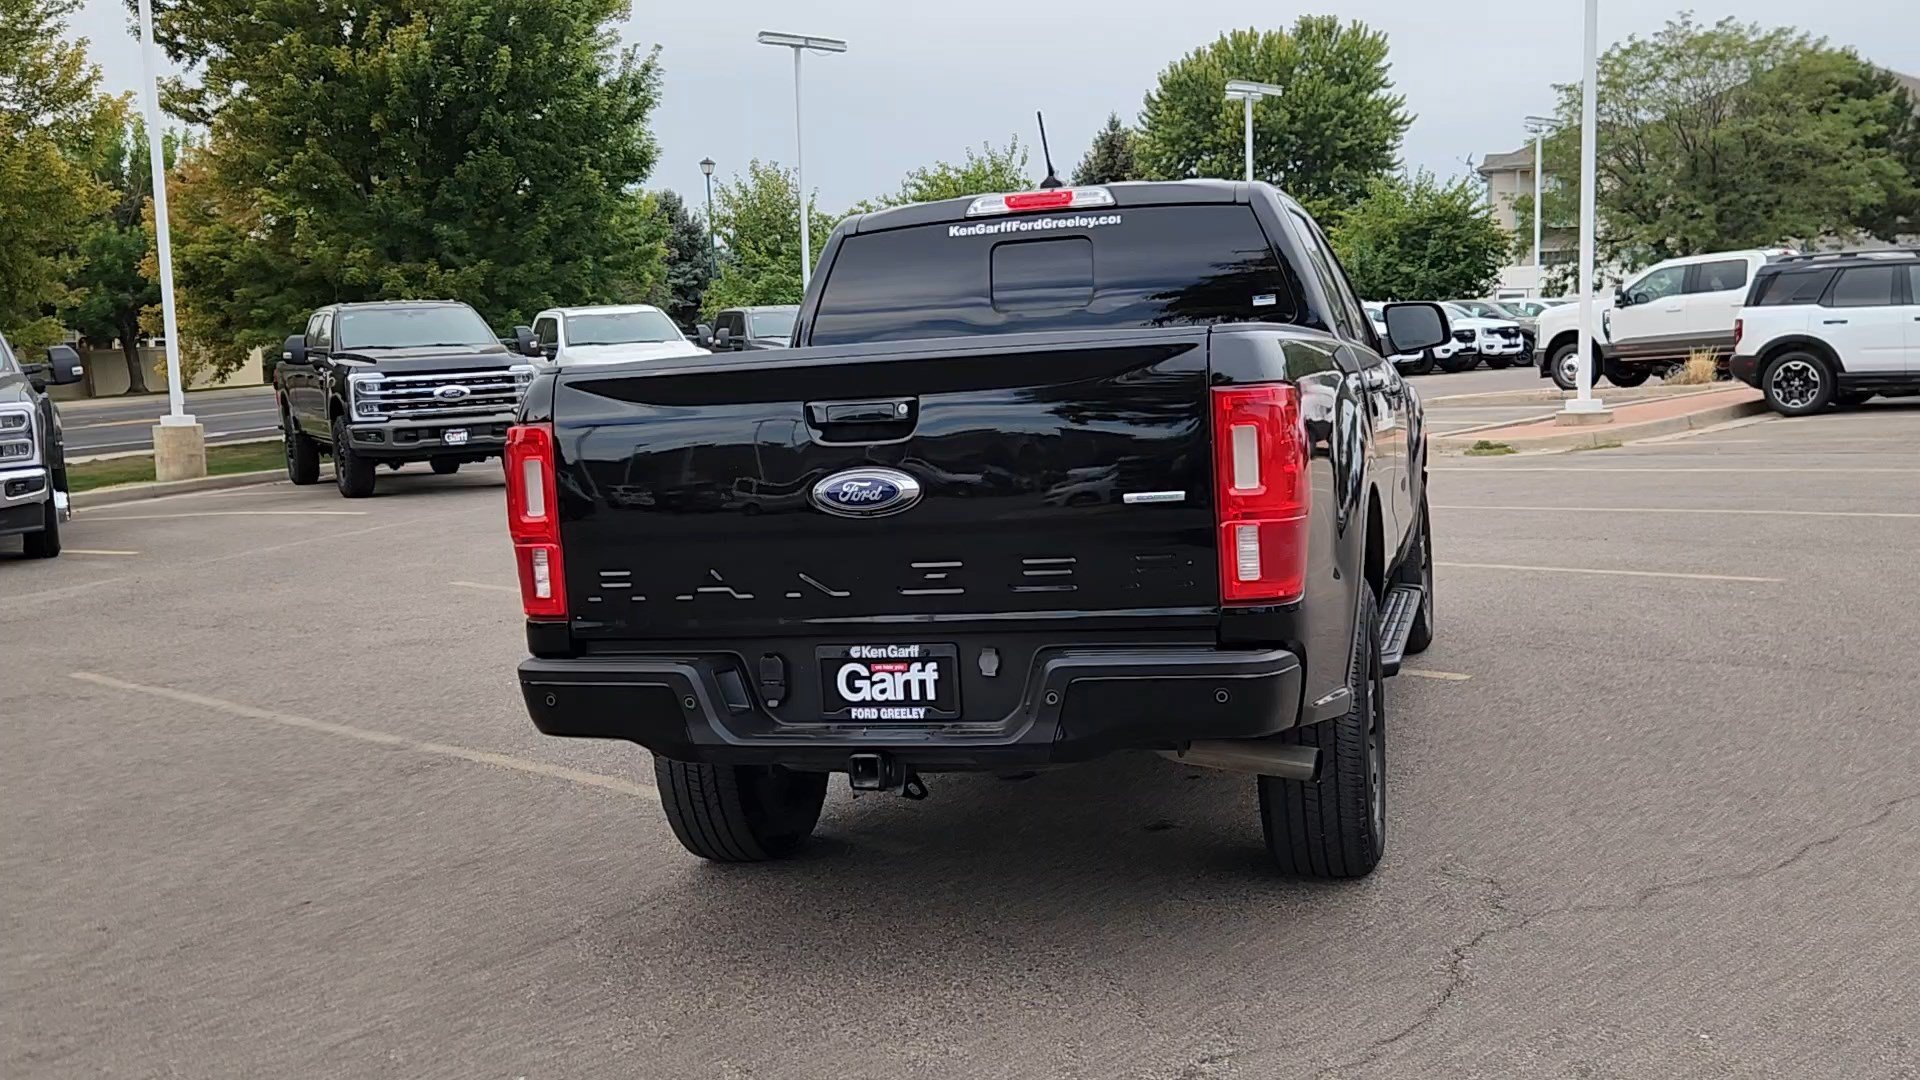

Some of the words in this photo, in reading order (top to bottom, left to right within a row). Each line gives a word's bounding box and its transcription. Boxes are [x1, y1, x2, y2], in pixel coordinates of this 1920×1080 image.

[838, 481, 883, 502] Ford
[861, 645, 887, 659] Ken
[887, 644, 920, 658] Garff
[836, 661, 939, 702] Garff
[851, 707, 878, 720] FORD
[880, 707, 926, 720] GREELEY
